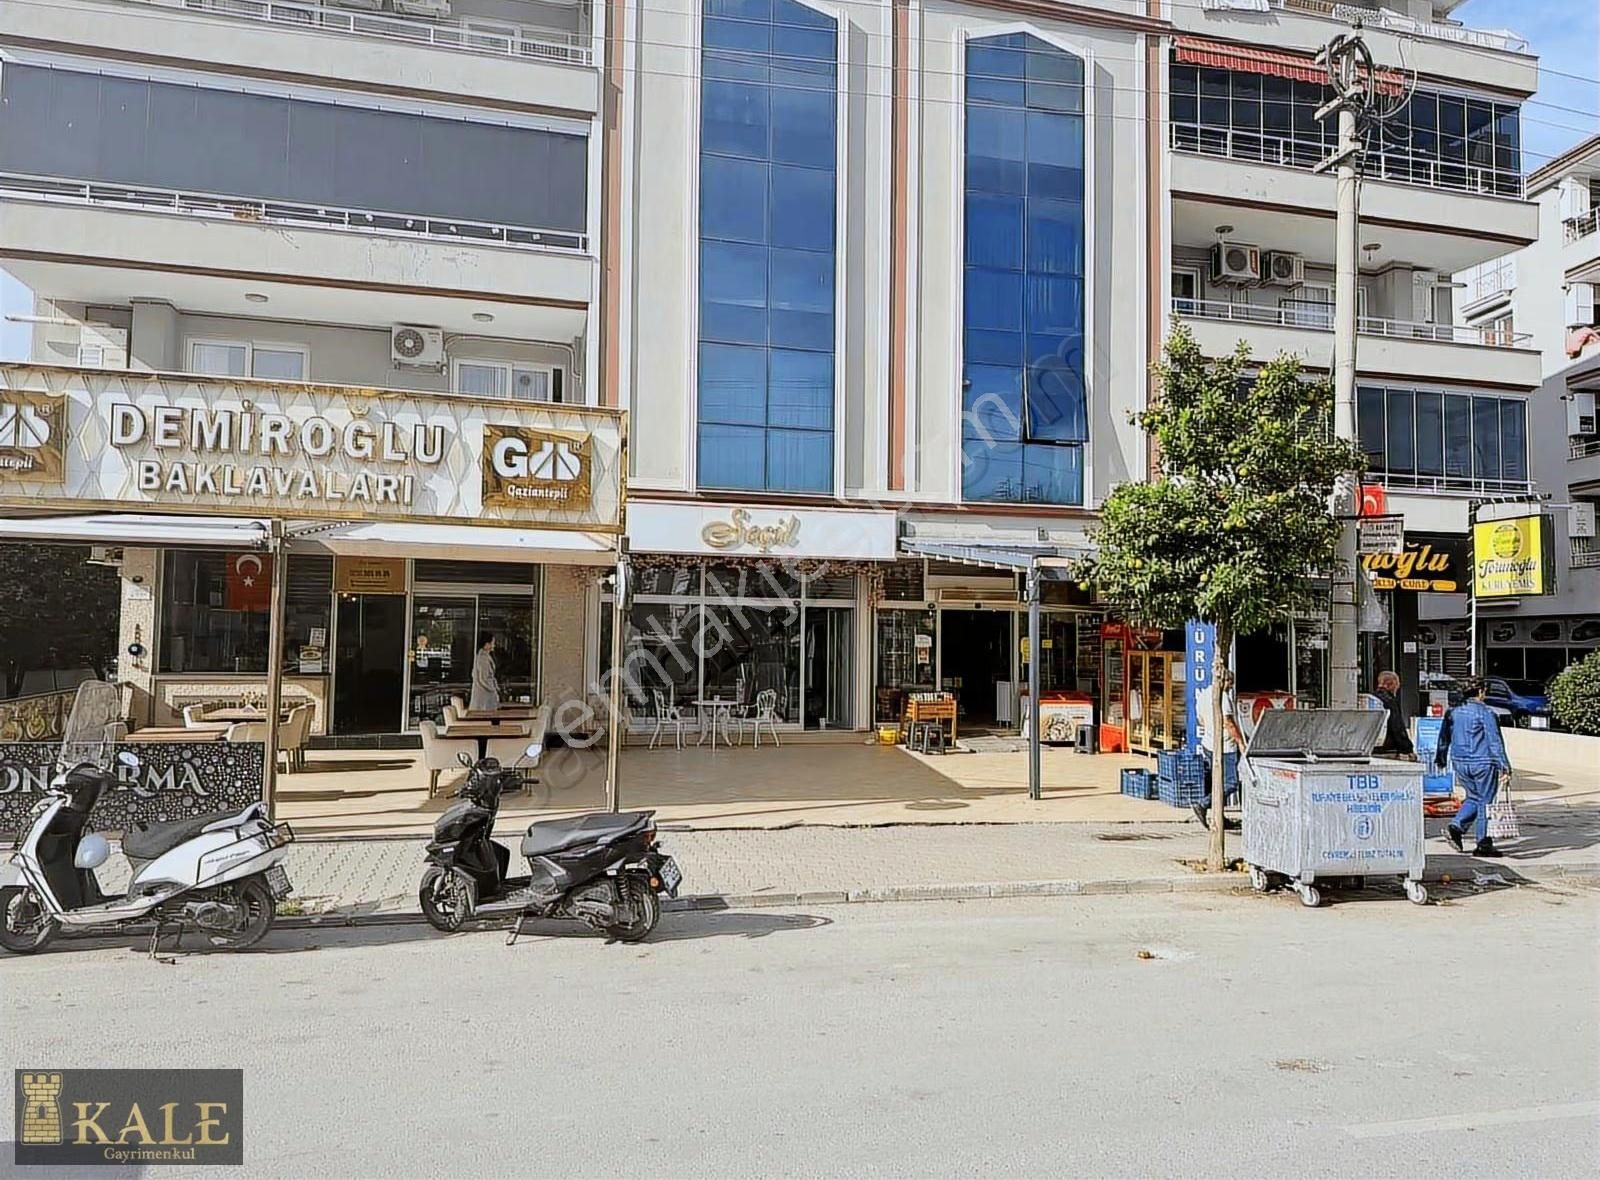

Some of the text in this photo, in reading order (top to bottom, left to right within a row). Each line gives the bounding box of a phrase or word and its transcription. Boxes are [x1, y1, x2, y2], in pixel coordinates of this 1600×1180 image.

[110, 399, 446, 464] DEMİROĞLU
[137, 459, 414, 506] BAKLAVALARI
[1346, 774, 1380, 790] TBB
